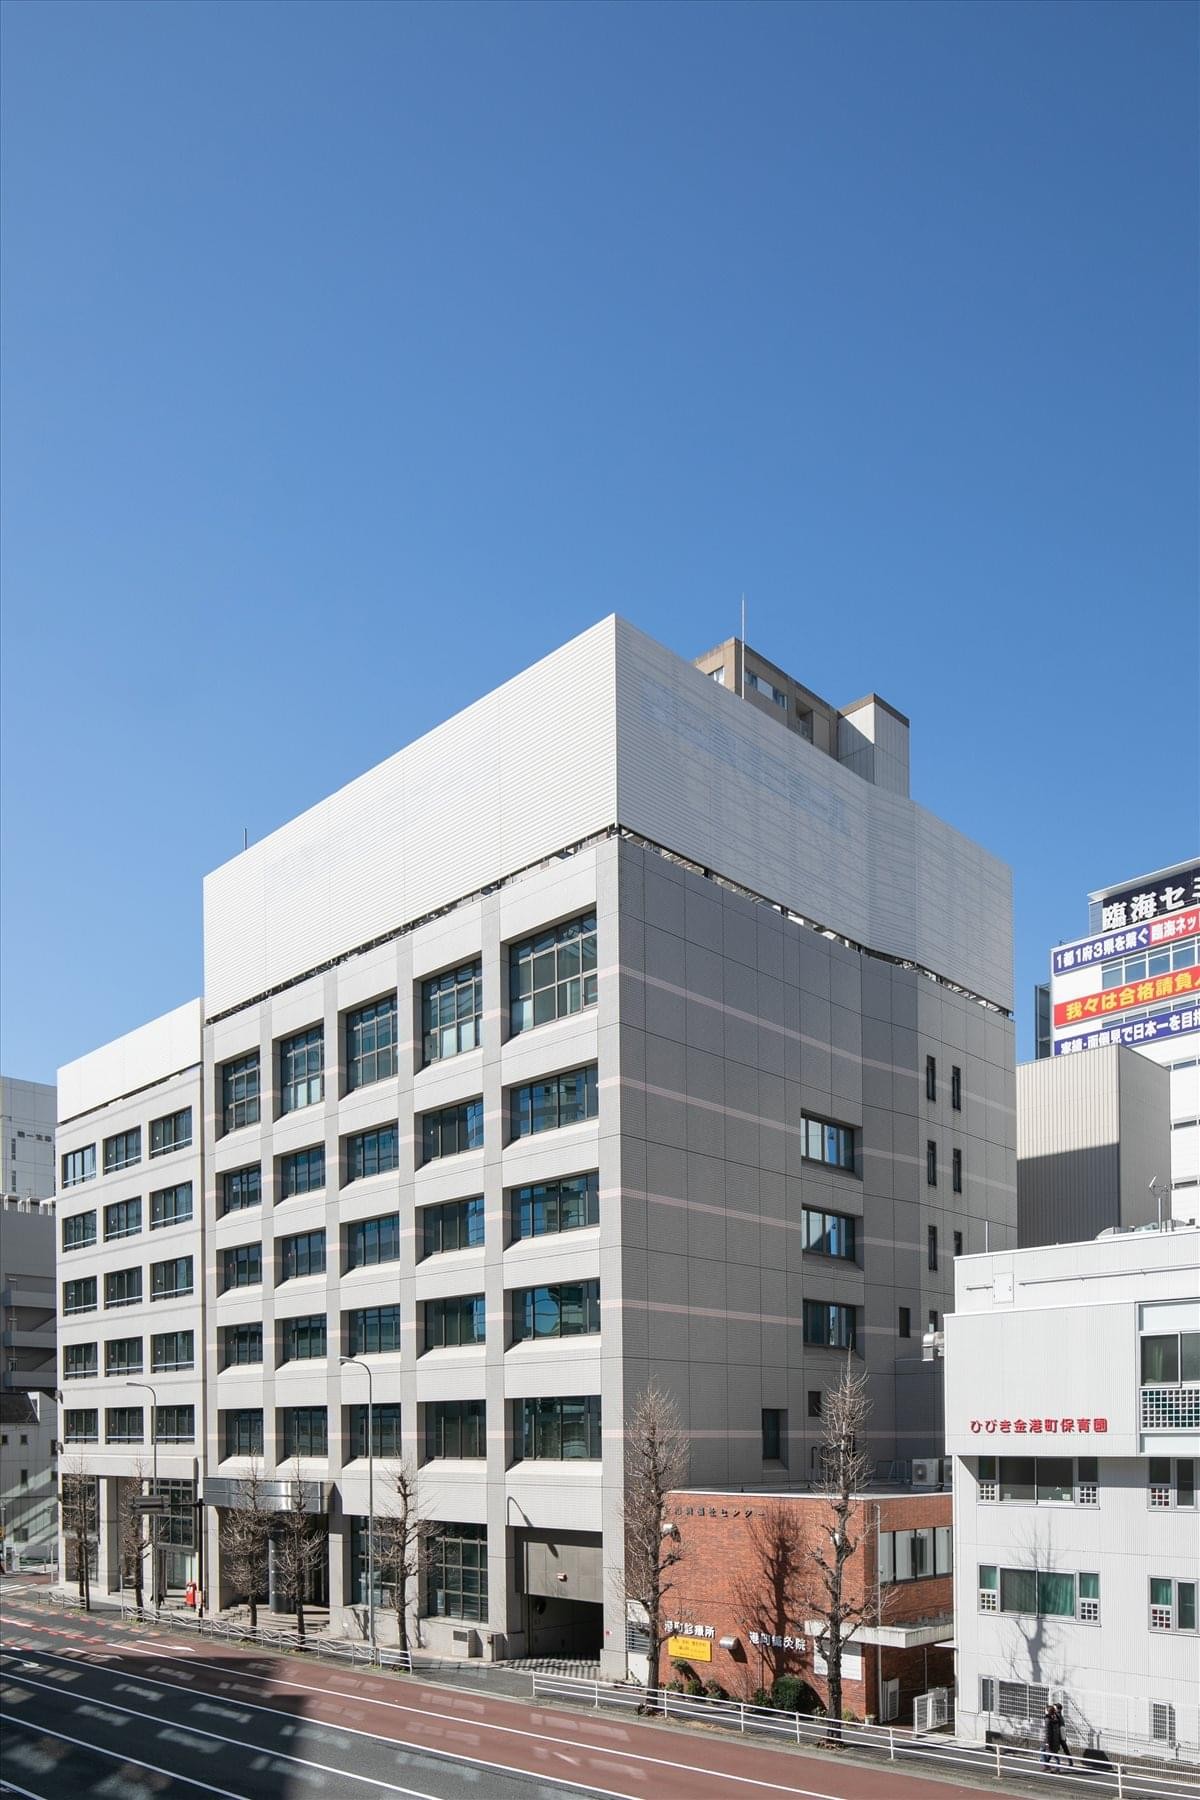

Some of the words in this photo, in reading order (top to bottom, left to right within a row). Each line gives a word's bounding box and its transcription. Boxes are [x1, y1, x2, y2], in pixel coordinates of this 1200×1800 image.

[1151, 911, 1200, 942] 臨海ネッ
[1066, 972, 1200, 1020] 我々は合格請負
[970, 1418, 1107, 1433] ひびき金港町保育園
